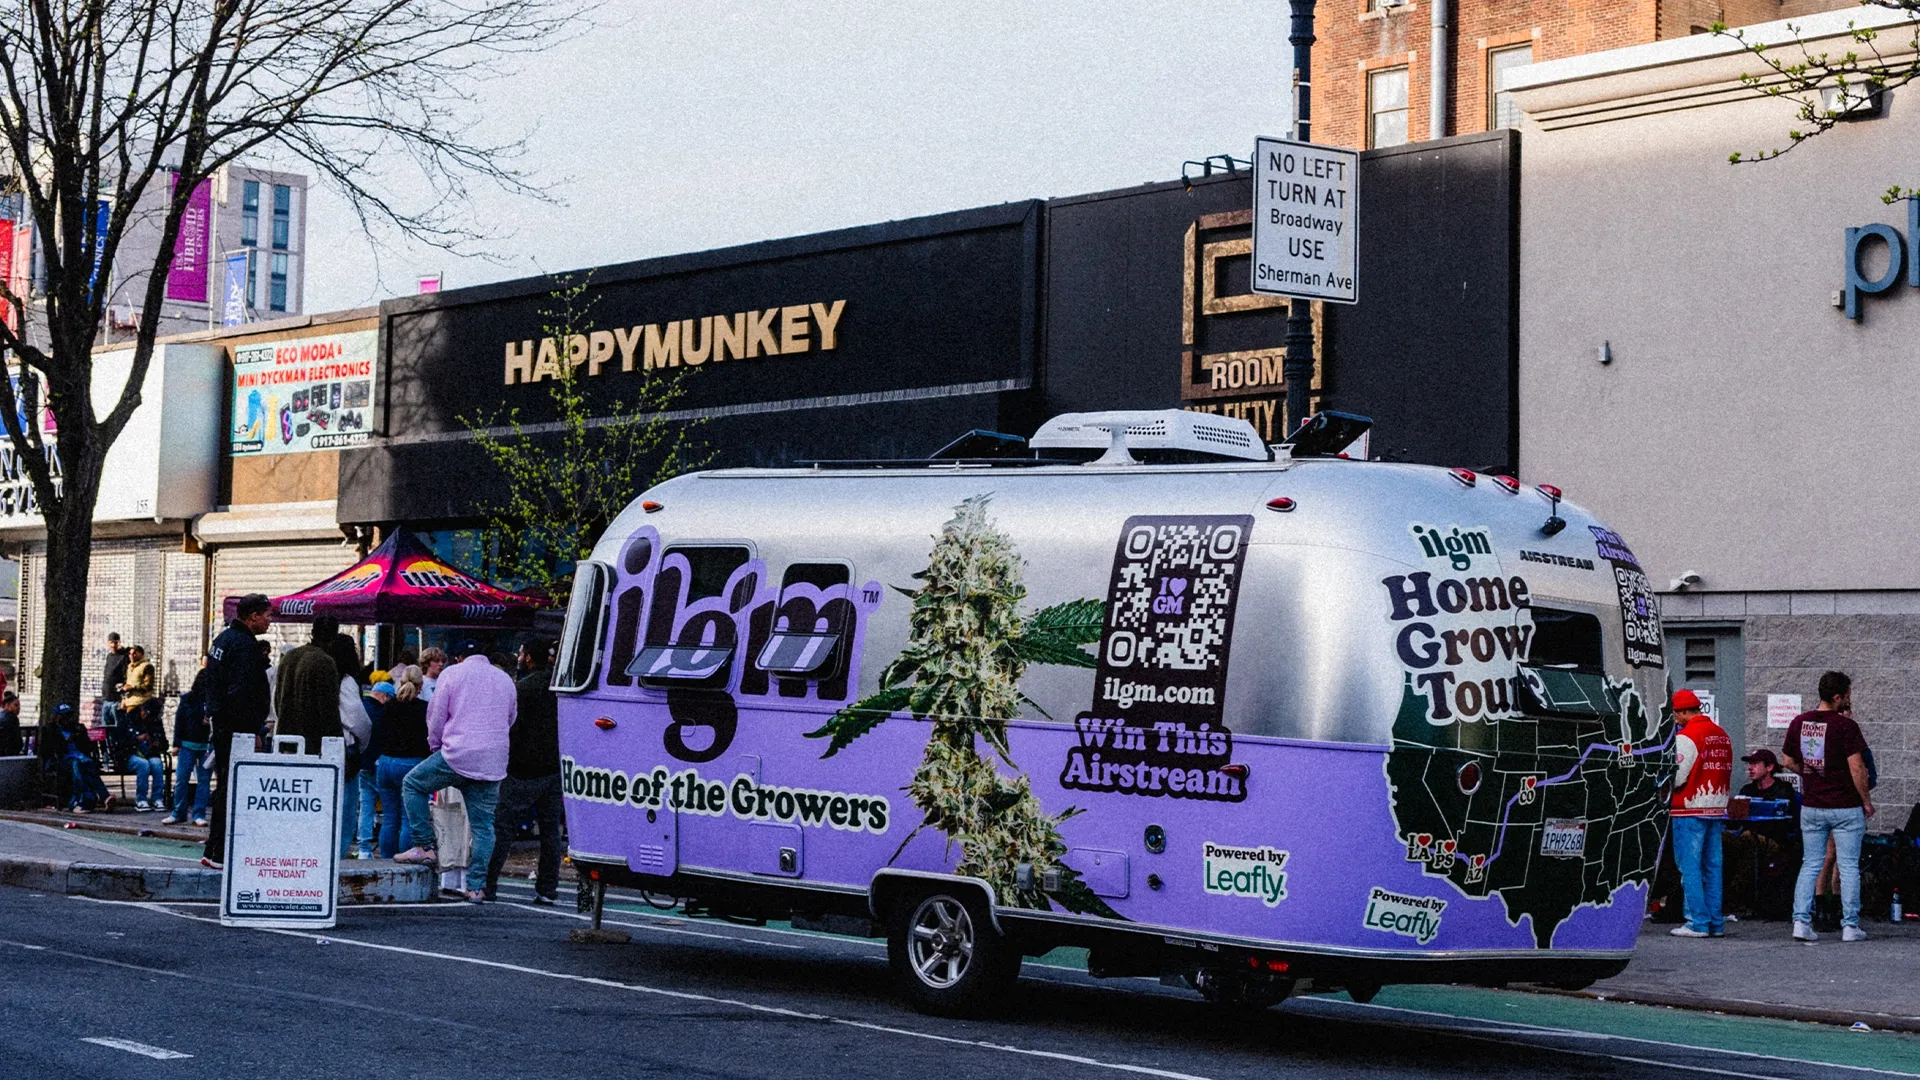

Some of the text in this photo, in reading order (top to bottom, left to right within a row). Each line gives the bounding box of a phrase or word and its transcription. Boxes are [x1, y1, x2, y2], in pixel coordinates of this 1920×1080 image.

[1269, 151, 1346, 181] NO LEFT
[1268, 180, 1346, 209] TURN AT
[195, 208, 205, 255] CENTERS
[1270, 208, 1343, 237] Broadway
[184, 206, 197, 272] FIBROID
[1288, 237, 1325, 261] USE
[175, 252, 184, 271] USA
[1843, 194, 1920, 320] p
[1258, 263, 1353, 290] Sherman Ave
[275, 346, 297, 365] ECO
[300, 342, 335, 362] MODA
[504, 299, 847, 386] HAPPYMUNKEY
[237, 361, 371, 387] MINI DYCKMAN ELECTRONICS
[1211, 354, 1285, 391] ROOM
[1413, 525, 1493, 572] ilgm
[1519, 550, 1595, 571] AIRSTREAM
[1160, 577, 1170, 595] I
[1381, 571, 1531, 621] Home
[1152, 596, 1184, 615] GM
[606, 536, 880, 764] ilgm TM
[1396, 622, 1533, 669] Grow
[1628, 647, 1663, 665] ilgm.com
[1102, 677, 1216, 709] ilgm.com
[1416, 671, 1542, 721] Tour
[1078, 718, 1228, 756] Win This
[1802, 723, 1825, 731] HOME
[259, 777, 313, 794] VALET
[1064, 752, 1242, 796] Airstream
[246, 795, 322, 813] PARKING
[561, 758, 888, 831] Home of the Growers
[1519, 790, 1535, 804] CO
[1407, 847, 1430, 860] LA
[1543, 832, 1583, 850] 1PH9268
[244, 857, 318, 868] PLEASE WAIT FOR
[1205, 844, 1287, 866] Powered by
[1435, 854, 1455, 867] PS
[257, 868, 306, 880] ATTENDANT
[1206, 860, 1285, 903] Leafly.
[1465, 868, 1483, 882] AZ
[266, 889, 324, 898] ON DEMAND
[1371, 889, 1446, 913] Powered by
[1366, 902, 1440, 942] Leafly.
